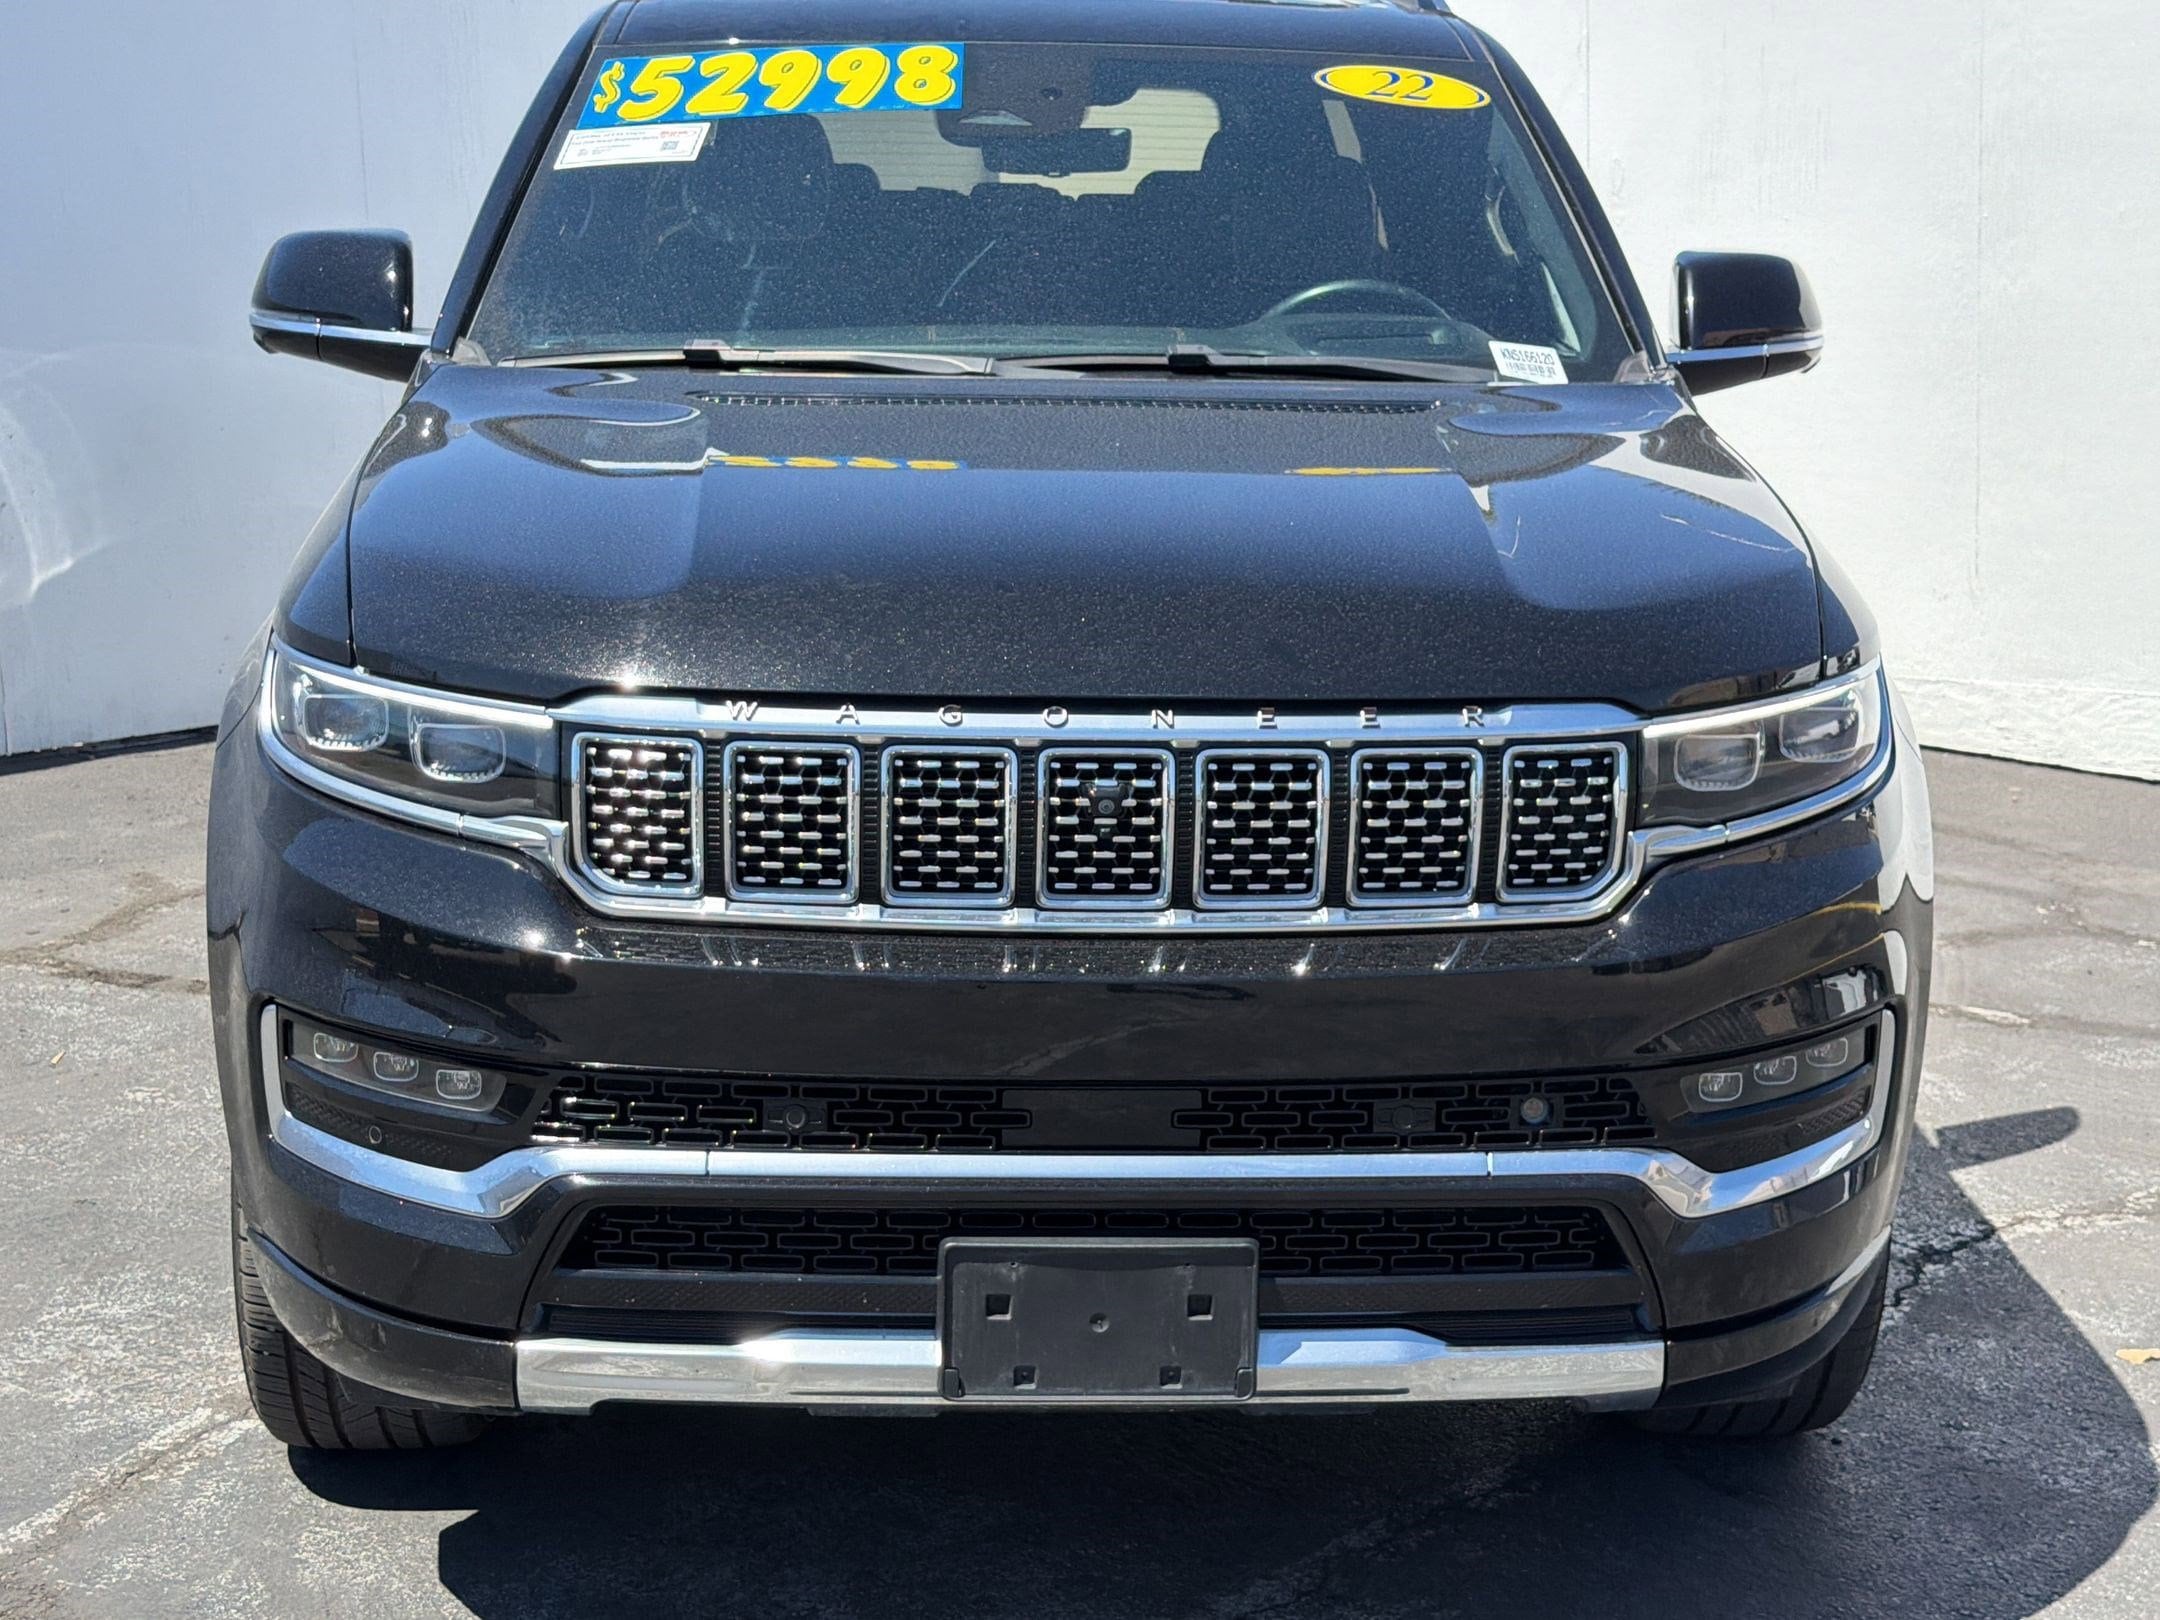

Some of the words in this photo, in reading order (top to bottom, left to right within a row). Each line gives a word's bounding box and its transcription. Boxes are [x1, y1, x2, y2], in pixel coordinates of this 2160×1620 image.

[593, 45, 960, 121] $52998
[1366, 71, 1433, 101] 22
[725, 700, 1485, 730] WAGONEER
